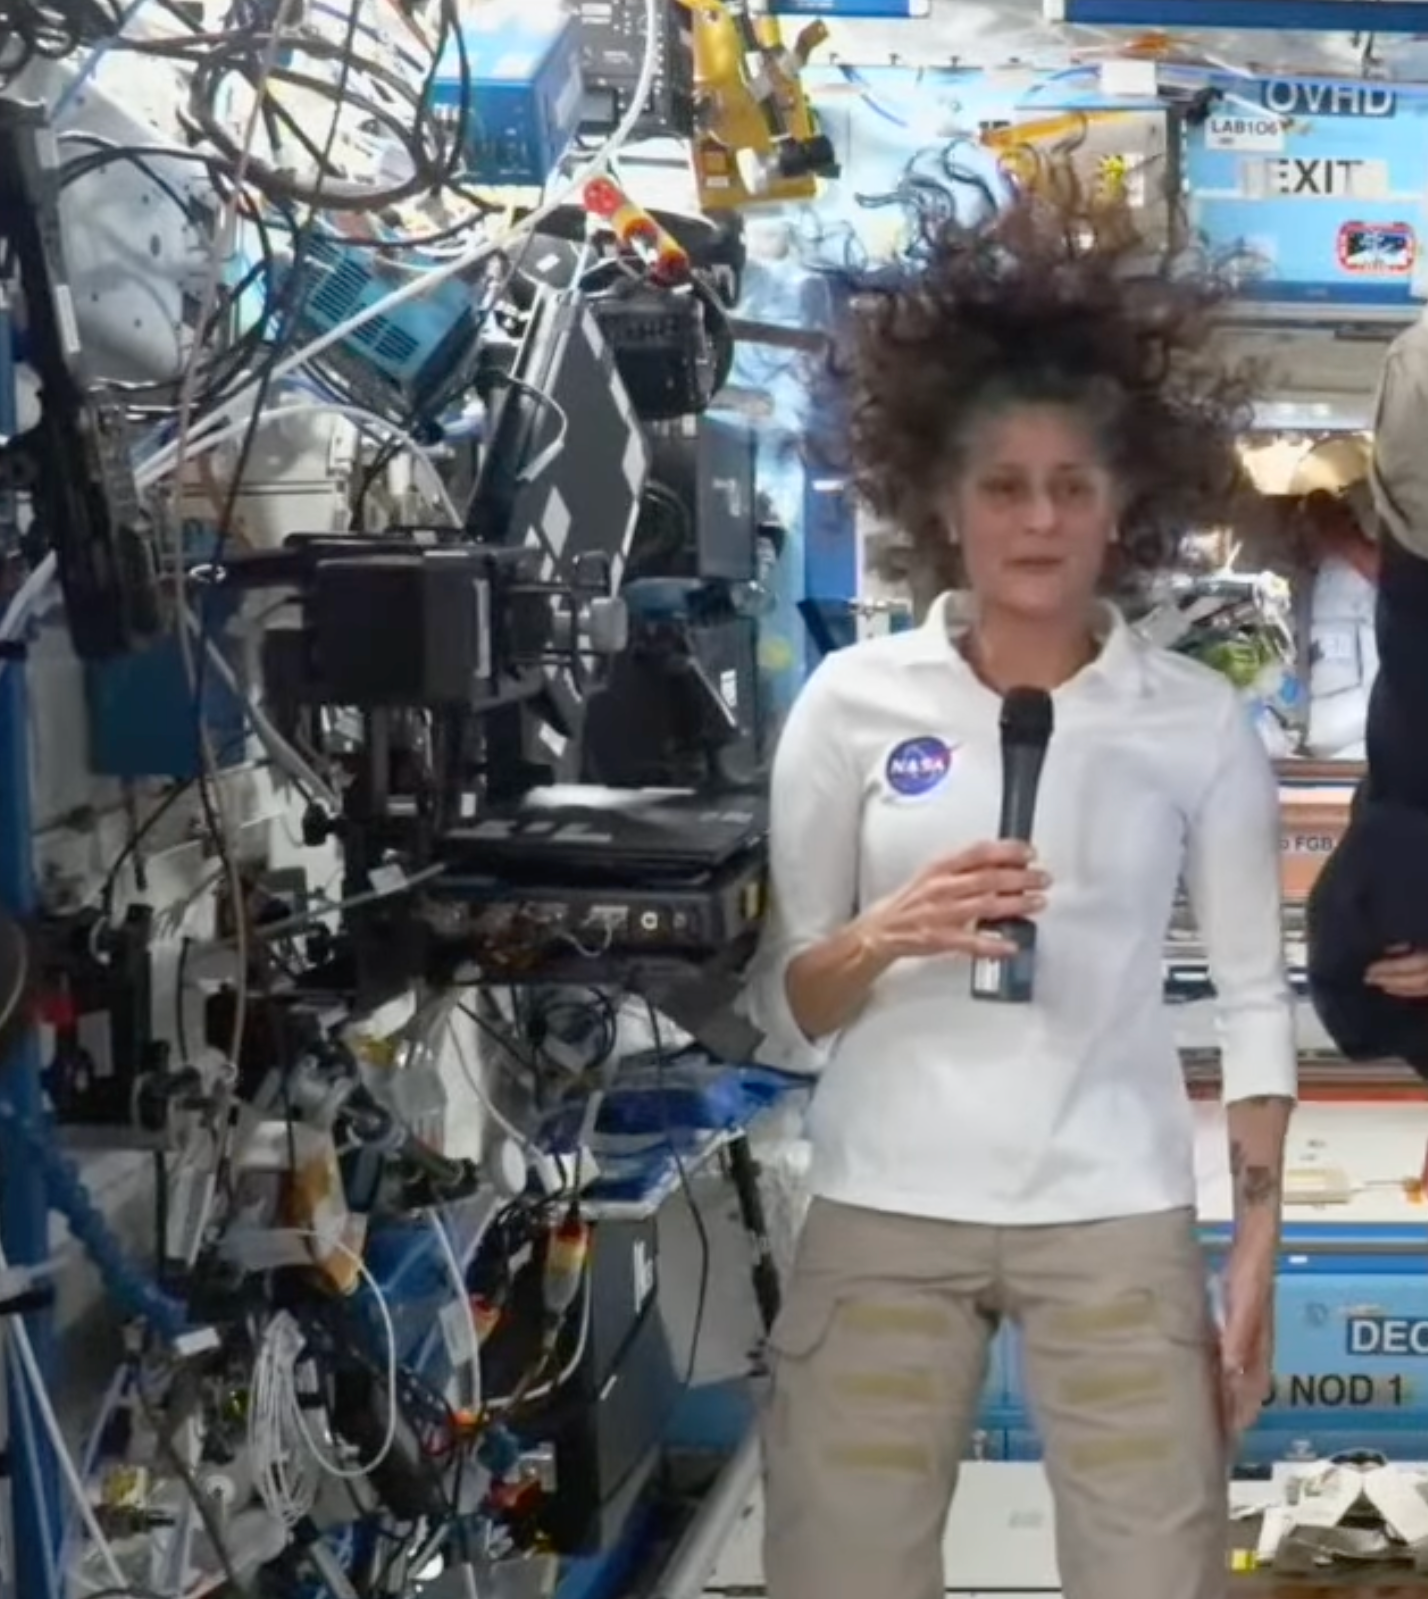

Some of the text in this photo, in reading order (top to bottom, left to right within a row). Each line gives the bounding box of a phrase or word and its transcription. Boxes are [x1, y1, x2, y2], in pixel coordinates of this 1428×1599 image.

[1265, 80, 1393, 115] OVHD
[1266, 158, 1364, 194] EXIT
[891, 757, 945, 773] NASA
[1290, 1373, 1374, 1406] NOD
[1388, 1373, 1402, 1406] 1
